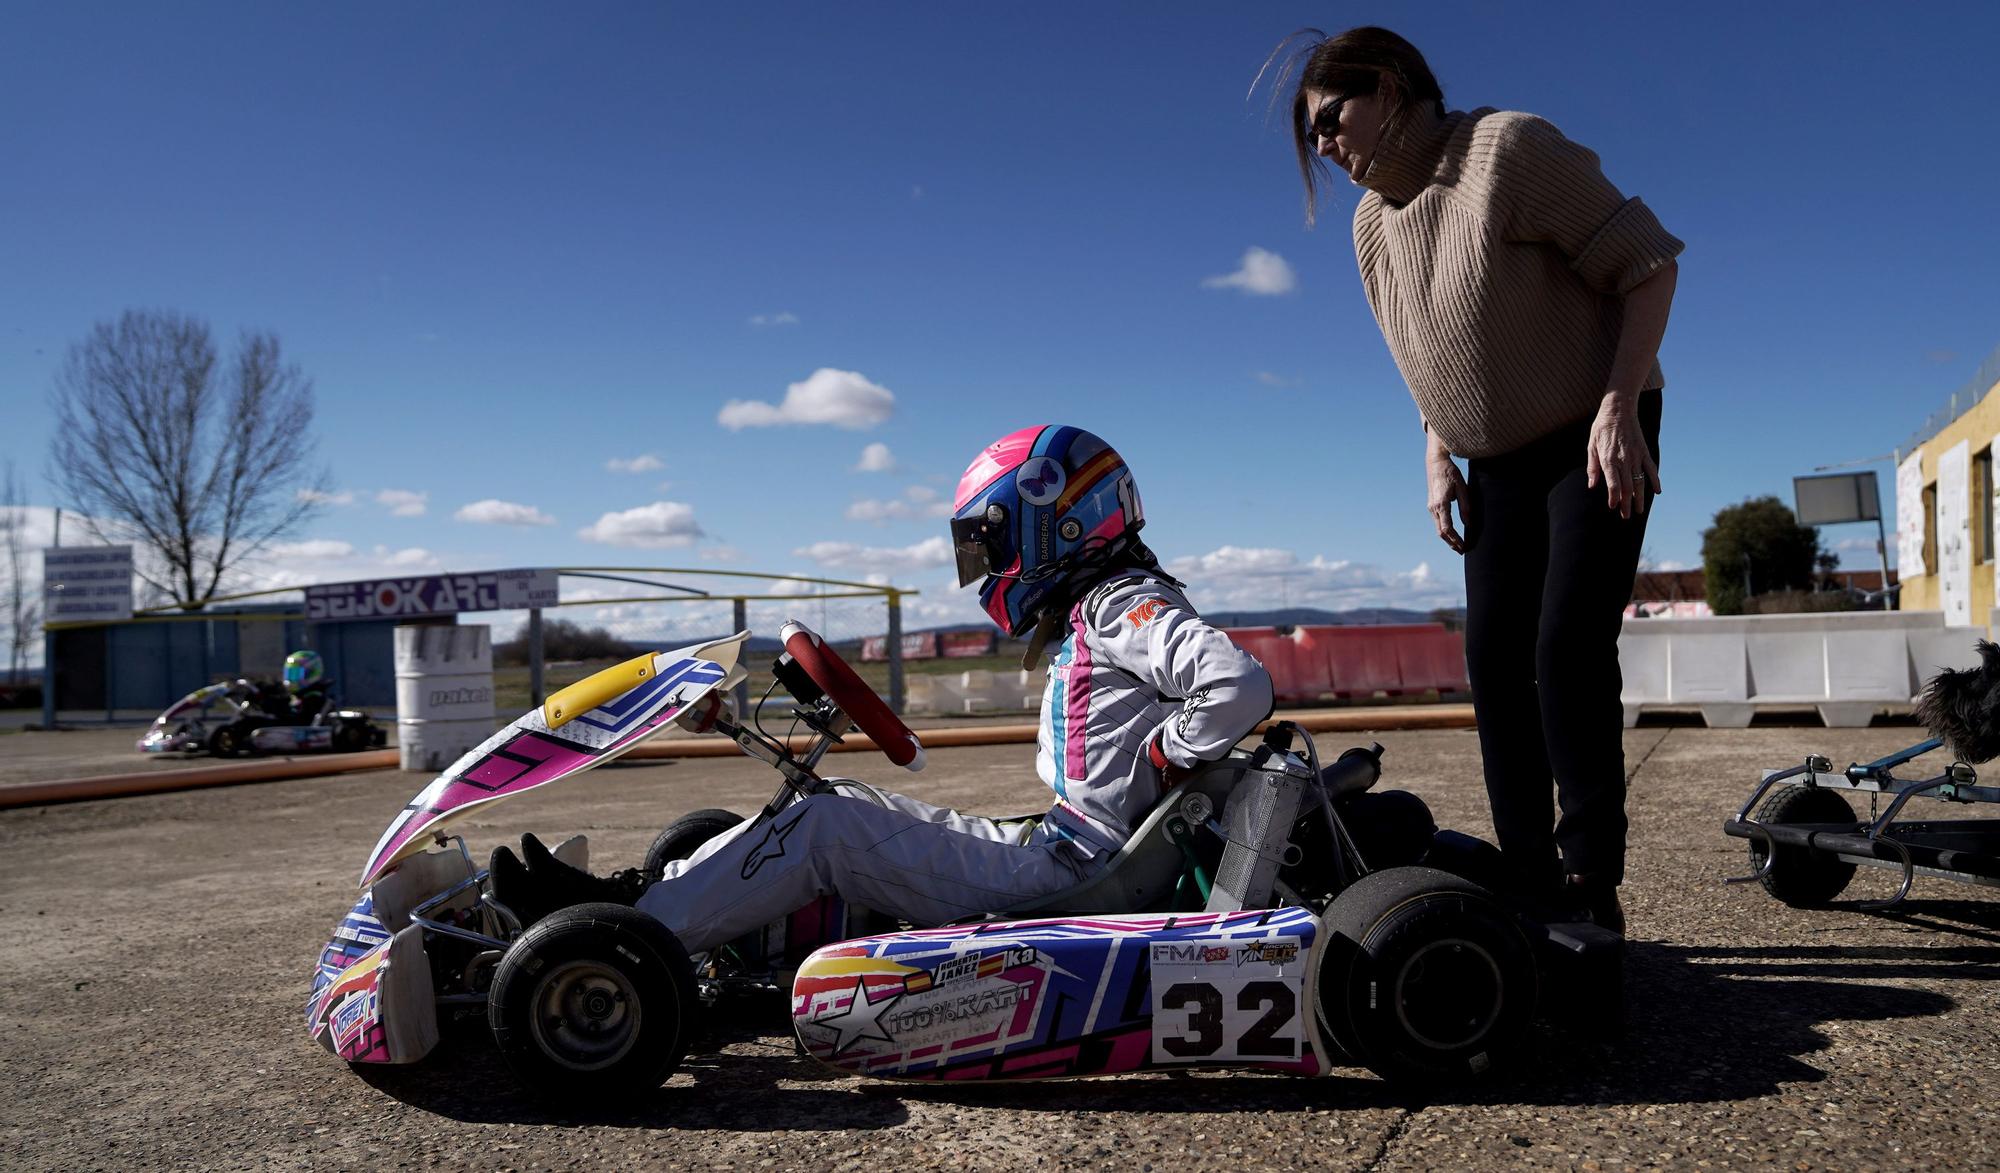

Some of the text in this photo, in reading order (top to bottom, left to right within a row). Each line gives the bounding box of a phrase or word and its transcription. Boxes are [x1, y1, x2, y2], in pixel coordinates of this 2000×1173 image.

[1041, 511, 1049, 560] BARRERAS
[941, 953, 978, 970] ROBERTO
[1153, 945, 1208, 960] FMA
[1162, 982, 1295, 1056] 32
